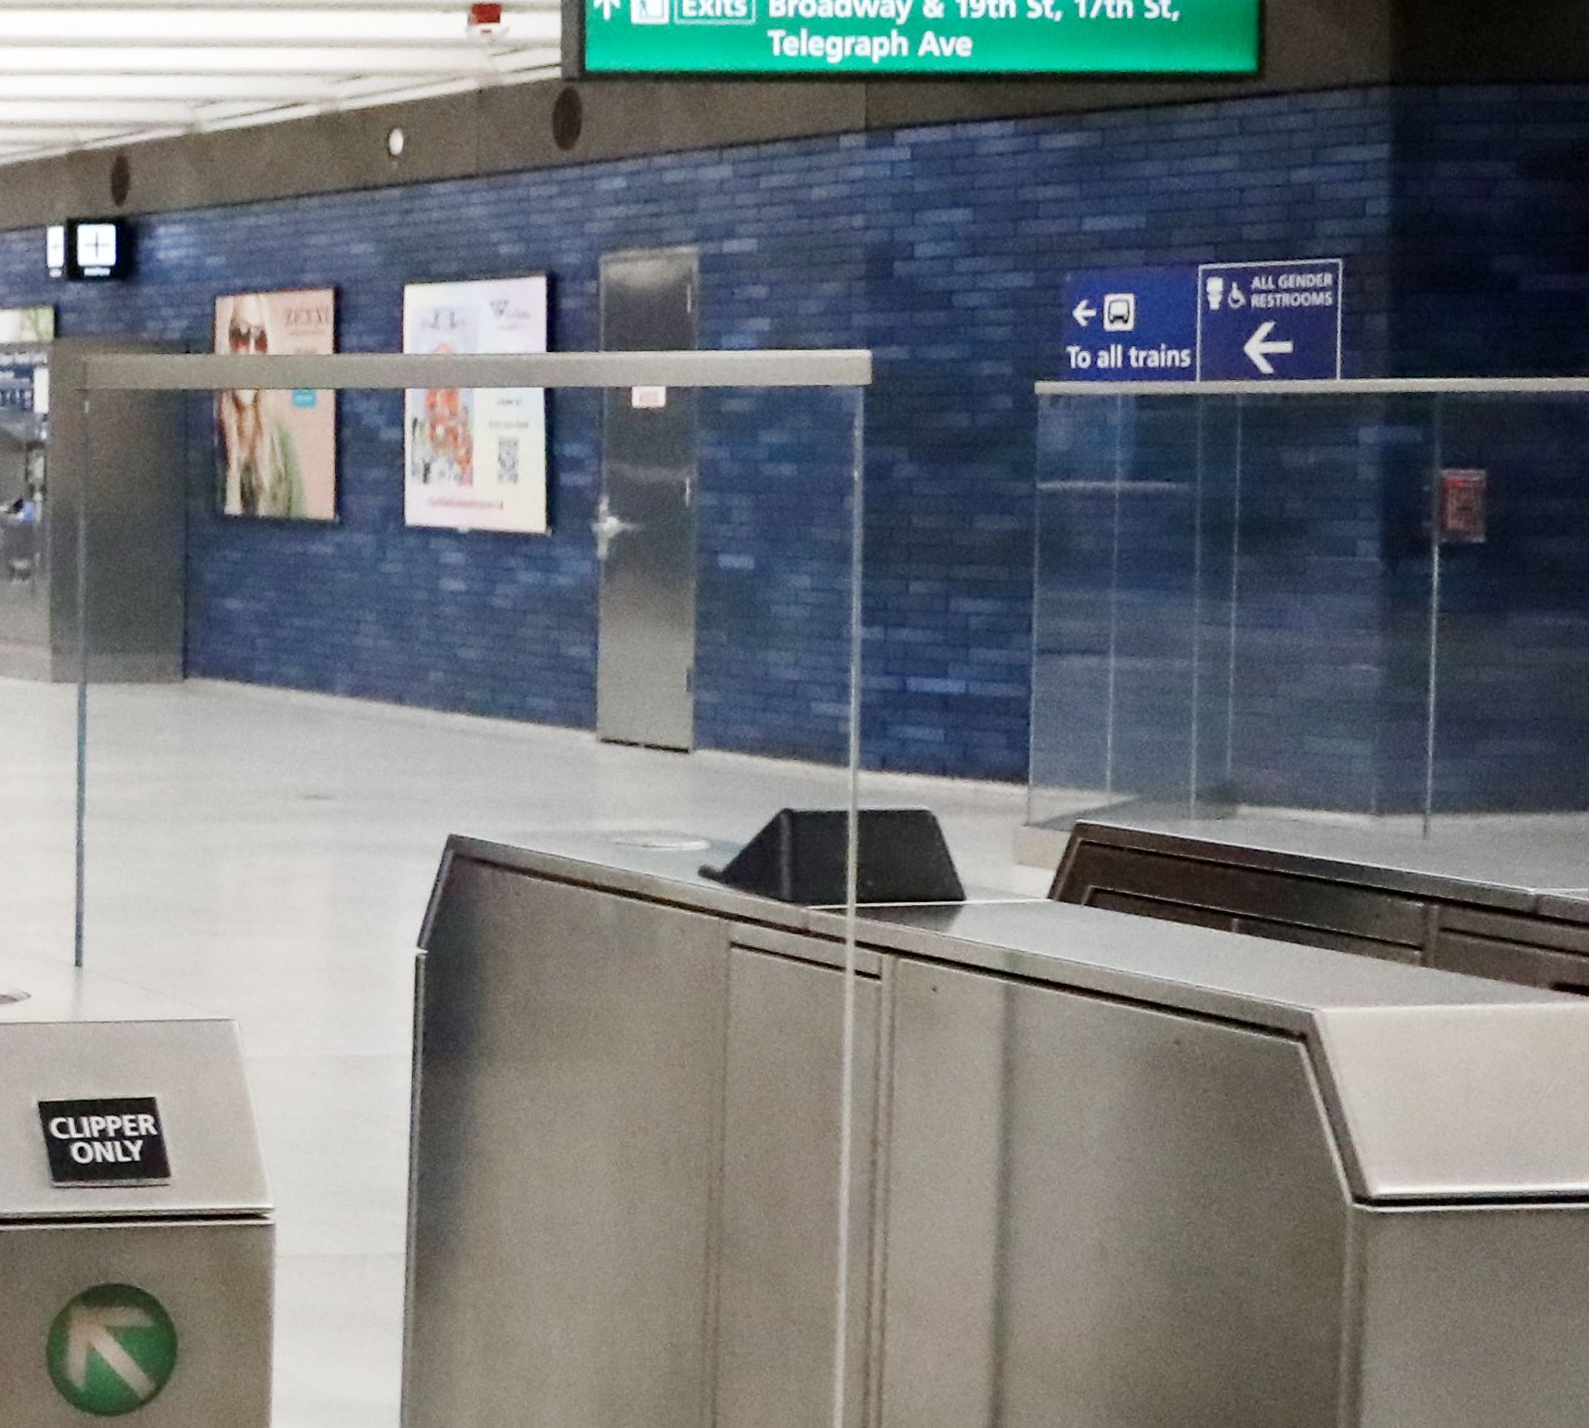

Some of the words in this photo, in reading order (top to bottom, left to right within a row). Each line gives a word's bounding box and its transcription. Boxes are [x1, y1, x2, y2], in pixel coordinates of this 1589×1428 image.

[767, 28, 909, 63] Telegraph
[917, 30, 974, 57] Ave
[1251, 275, 1275, 289] ALL
[1278, 273, 1333, 289] GENDER
[1251, 291, 1333, 308] RESTROOMS
[1066, 345, 1091, 369] To
[1097, 344, 1123, 368] all
[1129, 343, 1192, 368] trains
[49, 1114, 158, 1139] CLIPPER
[70, 1139, 143, 1164] ONLY
